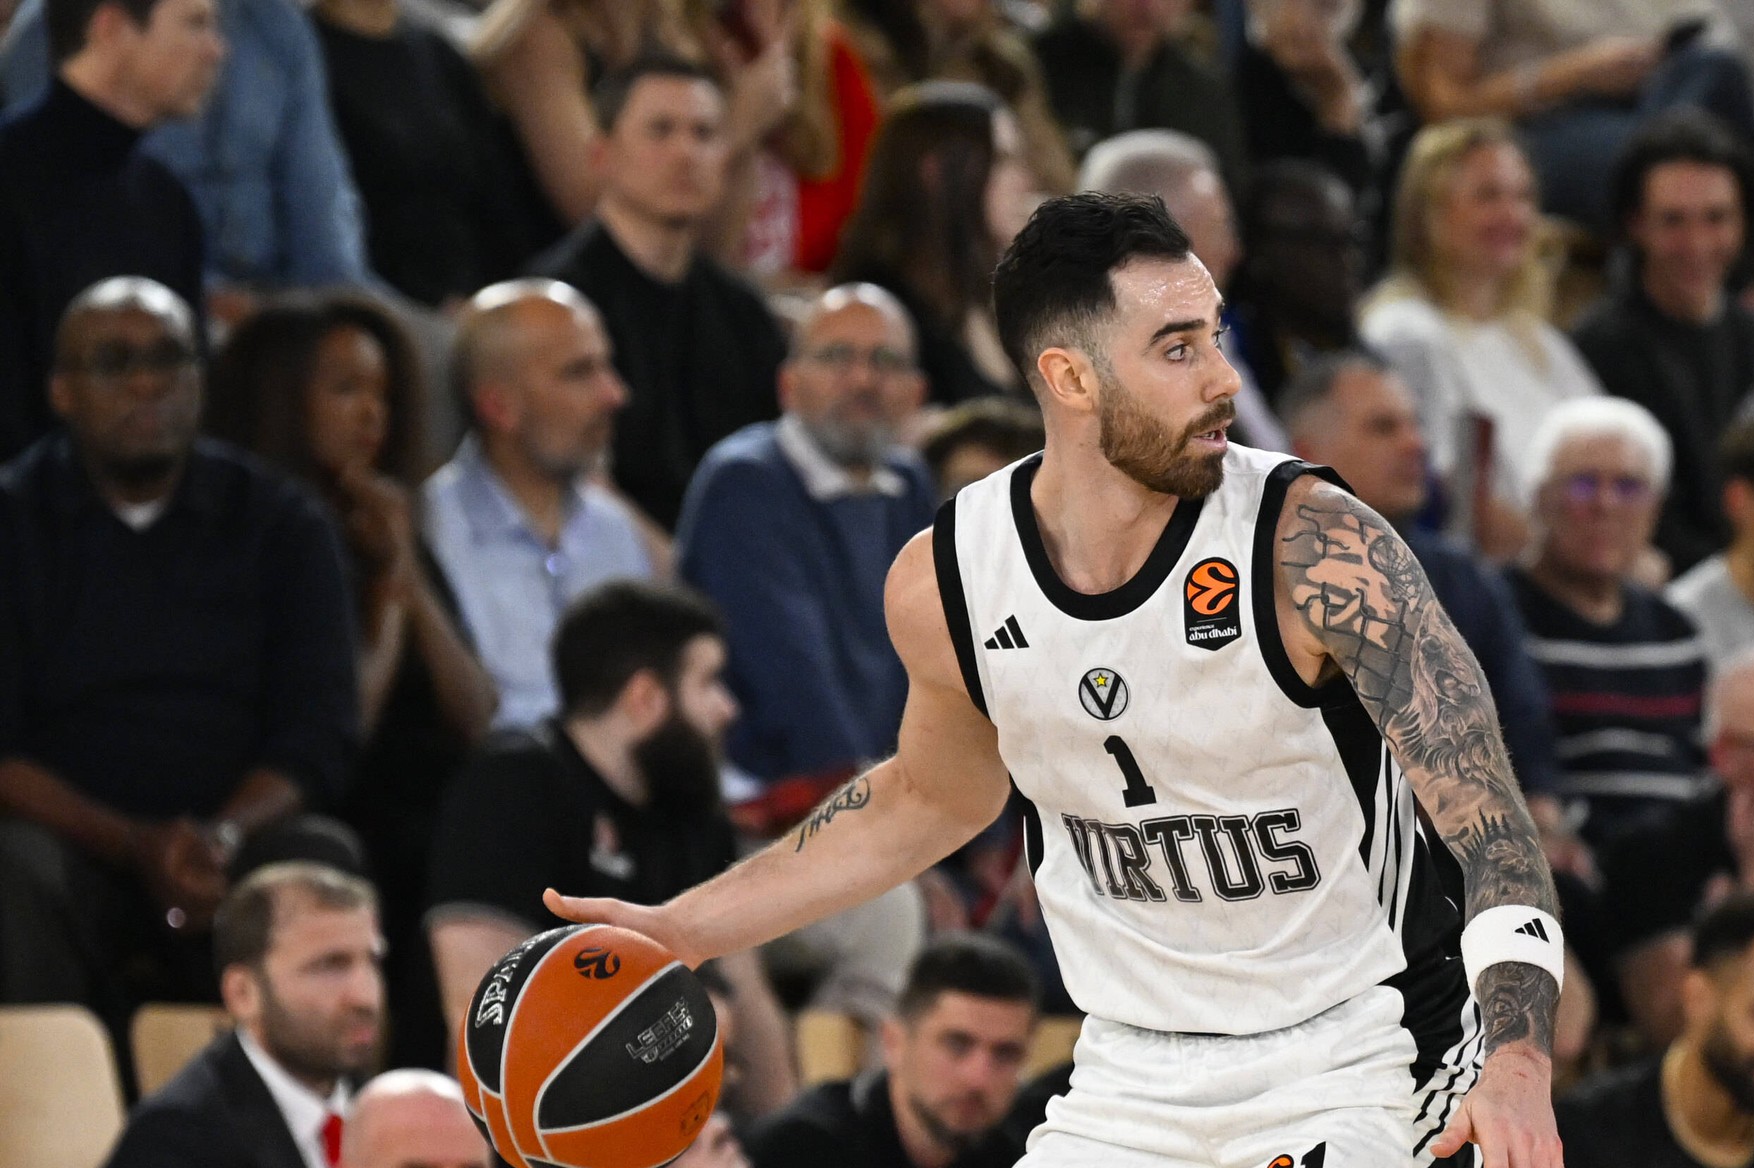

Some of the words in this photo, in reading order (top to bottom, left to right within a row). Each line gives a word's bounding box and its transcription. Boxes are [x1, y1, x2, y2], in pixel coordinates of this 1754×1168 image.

[1189, 630, 1208, 641] abu
[1208, 625, 1237, 639] dhabi
[1103, 735, 1157, 808] 1
[1061, 808, 1322, 902] VIRTUS
